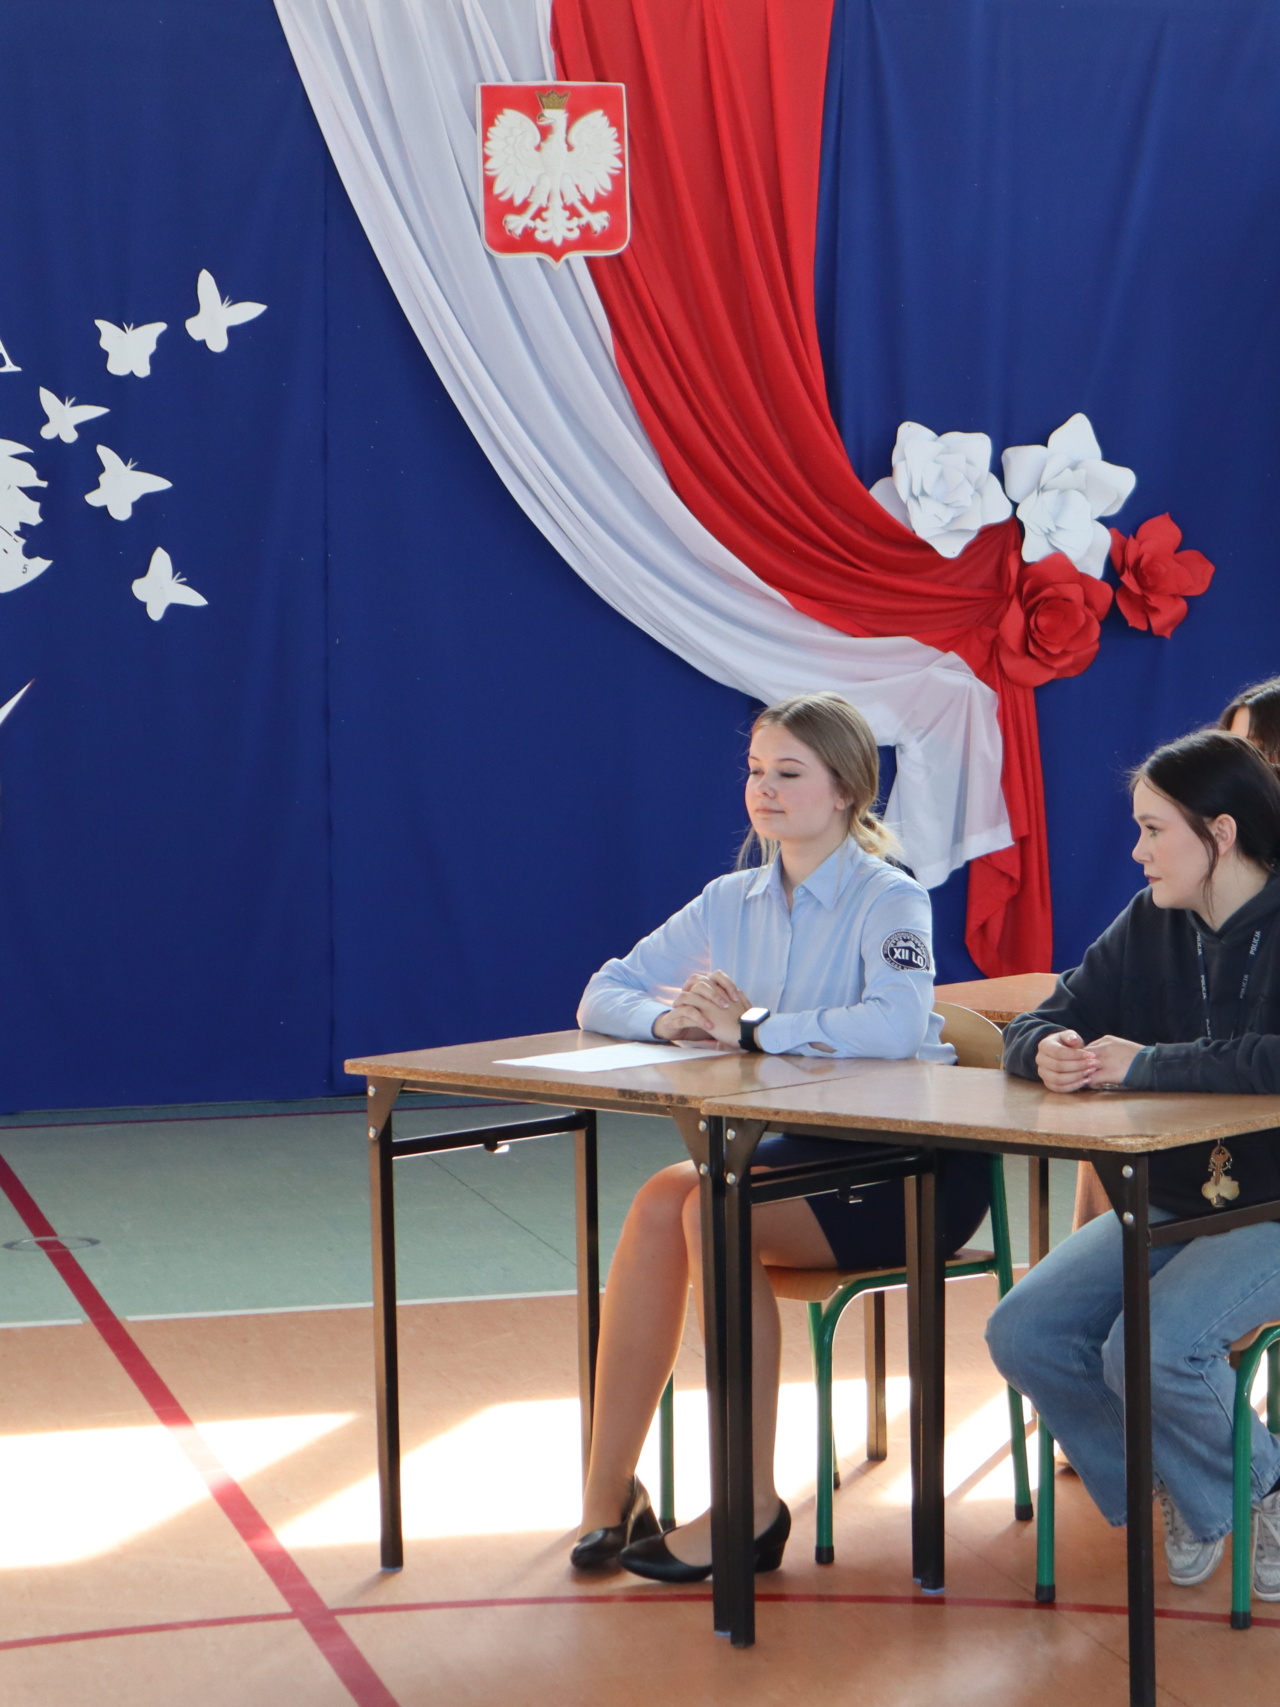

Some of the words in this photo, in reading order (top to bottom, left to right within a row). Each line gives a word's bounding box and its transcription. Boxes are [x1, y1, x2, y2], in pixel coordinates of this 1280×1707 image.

[21, 563, 29, 575] 5
[1250, 931, 1261, 955] POLICJA
[893, 948, 909, 961] XII
[912, 951, 924, 967] LO
[1240, 974, 1249, 999] POLICJA
